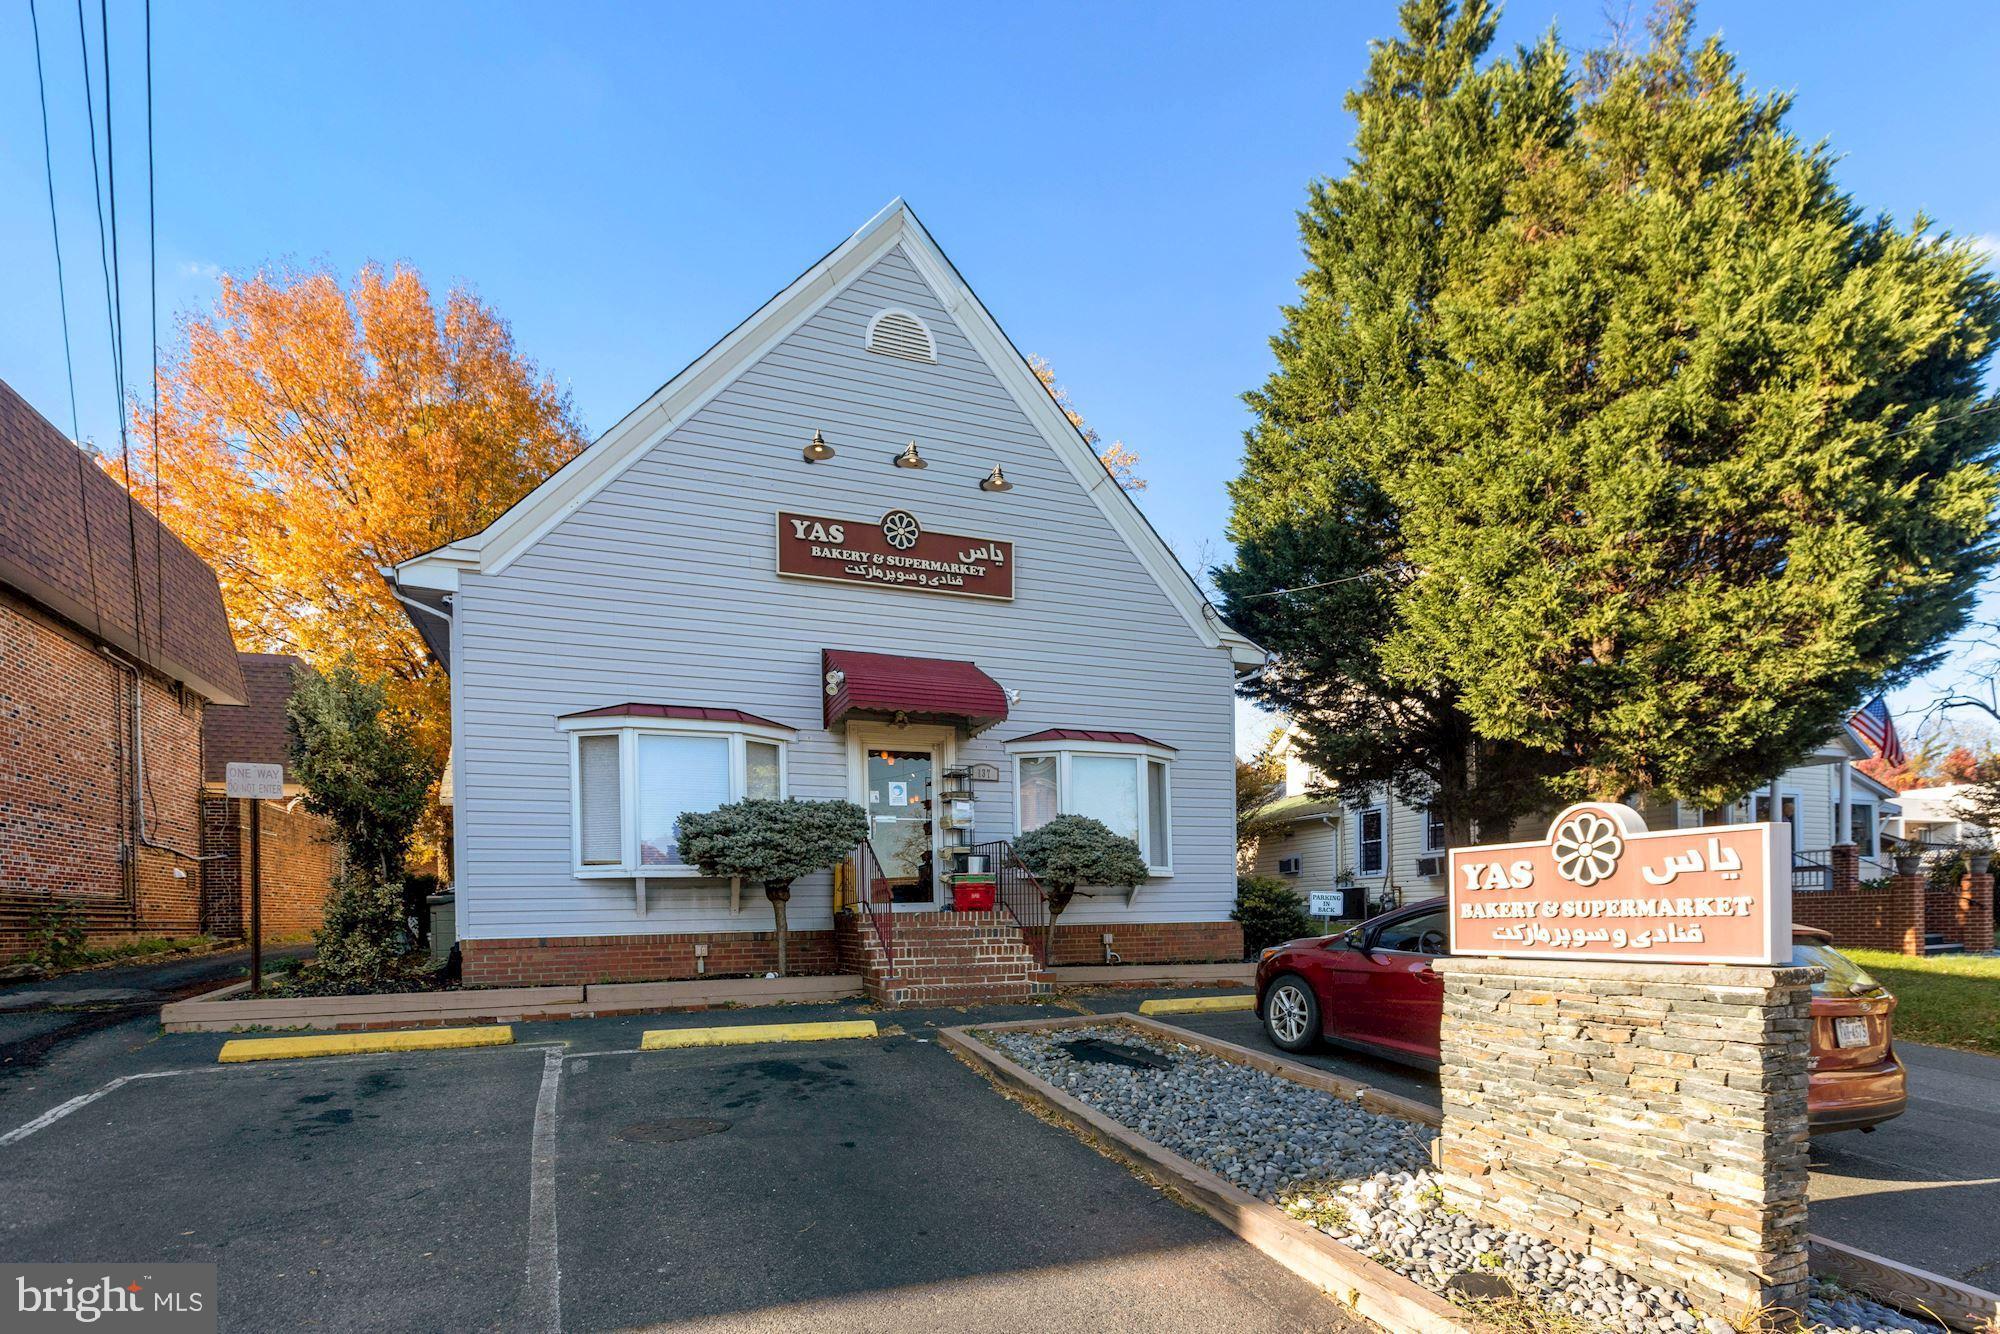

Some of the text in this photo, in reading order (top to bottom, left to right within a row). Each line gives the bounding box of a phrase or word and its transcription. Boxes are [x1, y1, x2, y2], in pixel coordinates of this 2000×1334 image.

[791, 519, 845, 544] YAS
[811, 546, 986, 577] BAKERY & SUPERMARKET
[229, 767, 280, 780] ONE WAY
[228, 782, 282, 794] DO NOT ENTER
[1461, 860, 1534, 890] YAS
[1460, 896, 1753, 919] BAKERY & SUPERMARKET
